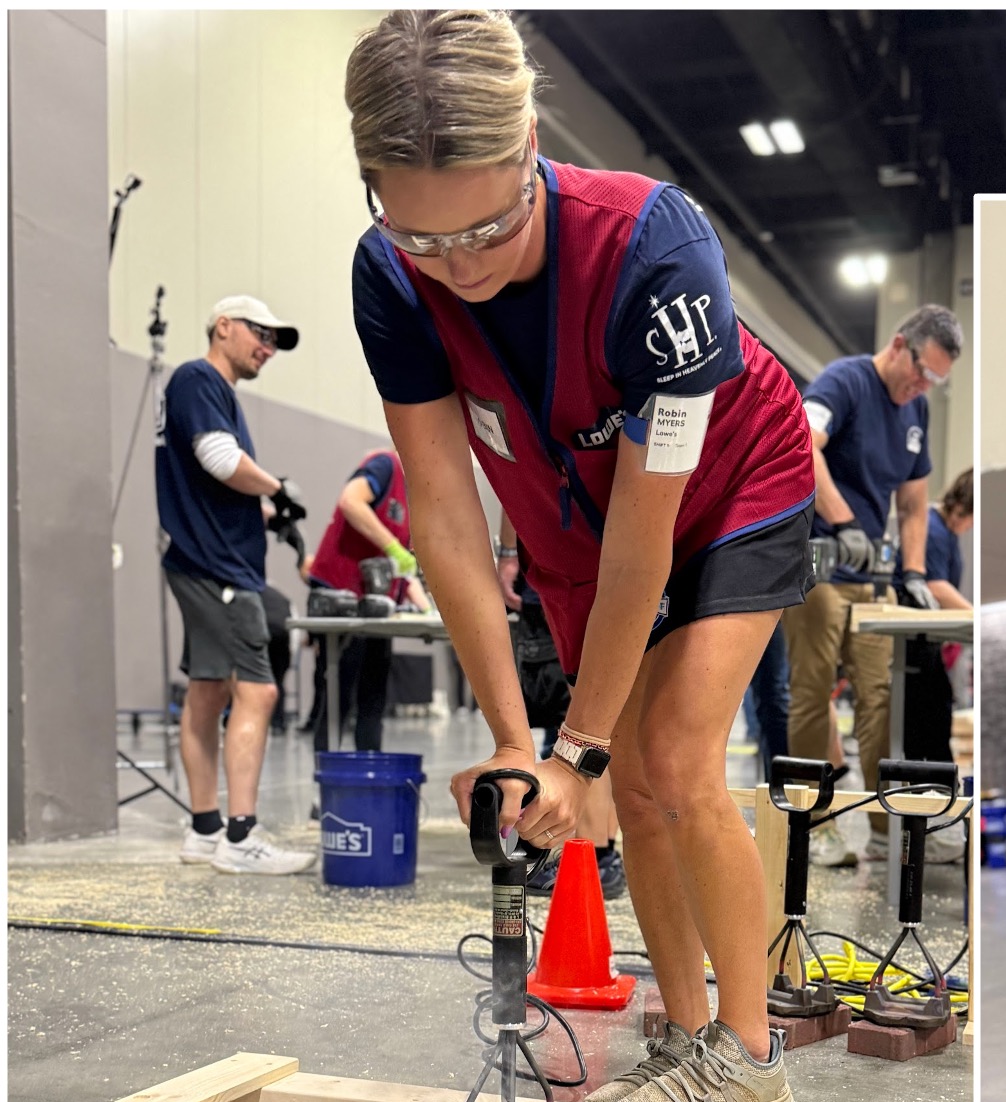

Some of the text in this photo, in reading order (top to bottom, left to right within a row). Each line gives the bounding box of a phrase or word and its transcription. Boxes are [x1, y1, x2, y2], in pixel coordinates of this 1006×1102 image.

[656, 374, 675, 383] SLEEP
[675, 371, 682, 379] IN
[657, 407, 687, 418] Robin
[656, 418, 686, 427] MYERS
[578, 409, 626, 448] LOWE'
[655, 429, 677, 437] Lowe's
[322, 830, 362, 852] WE'S
